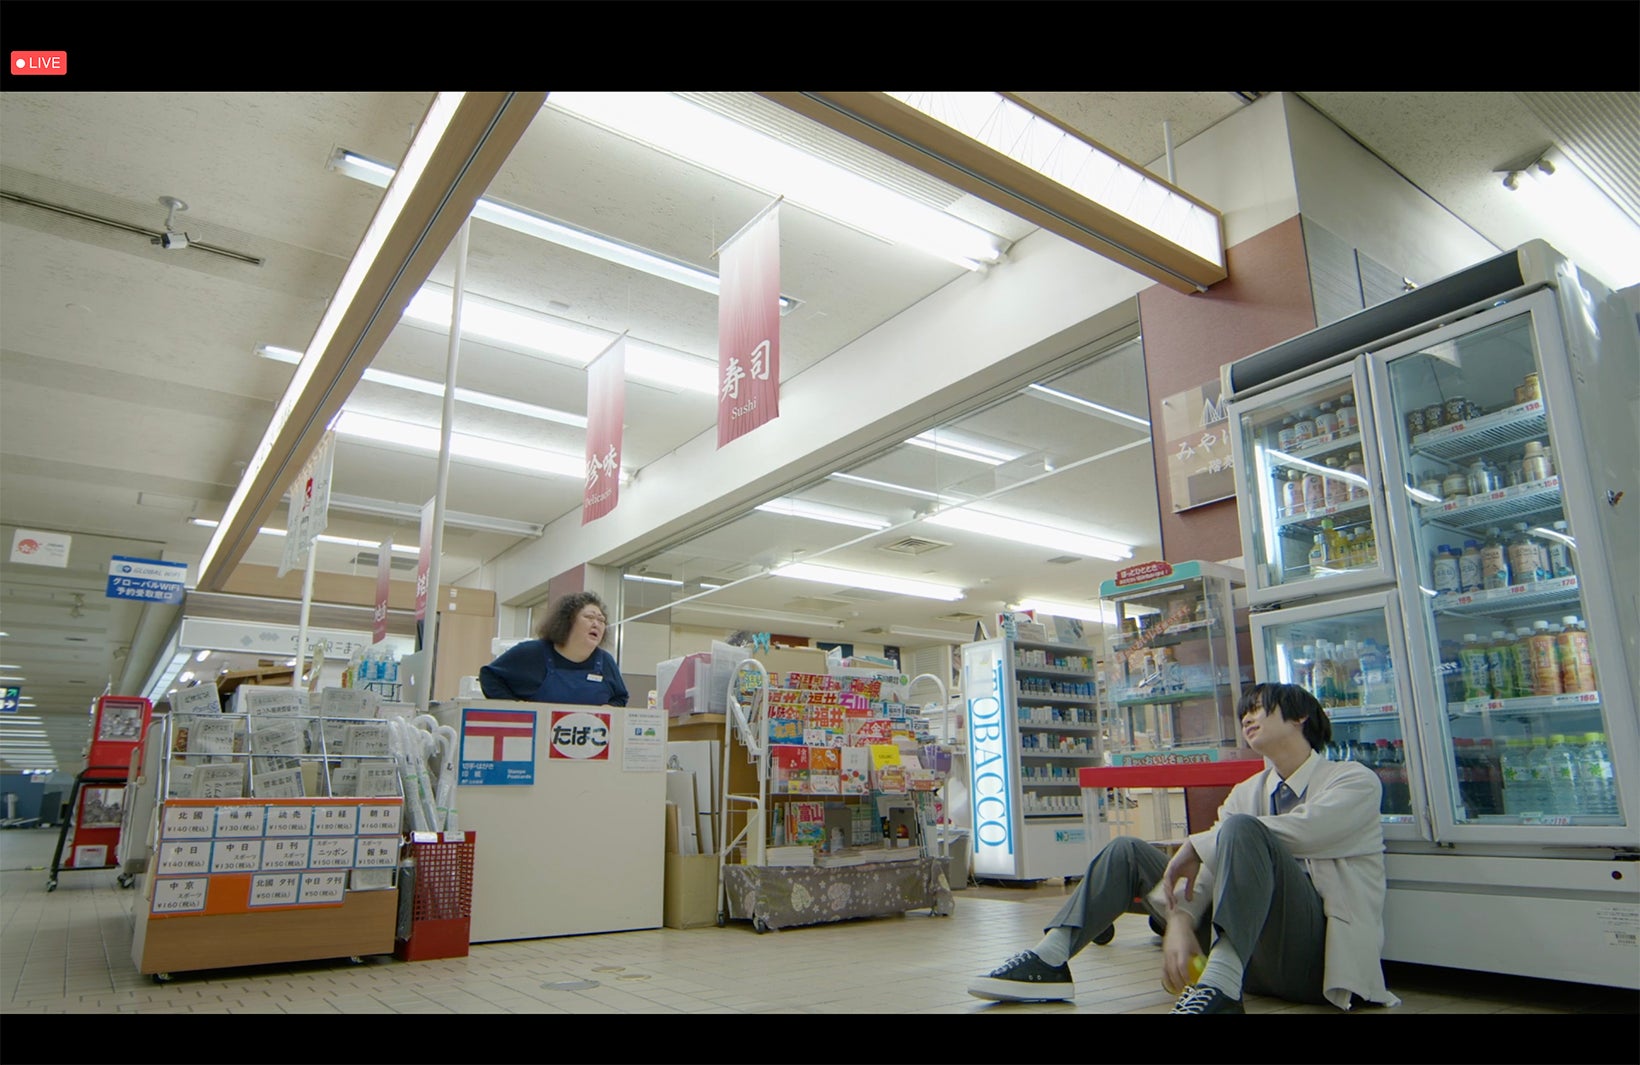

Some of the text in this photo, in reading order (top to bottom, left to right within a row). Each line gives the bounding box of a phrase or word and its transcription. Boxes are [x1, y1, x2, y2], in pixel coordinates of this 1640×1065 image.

[721, 339, 771, 402] 寿司
[731, 396, 758, 419] Sushi
[585, 444, 618, 490] 珍味
[814, 706, 843, 728] 福井
[553, 725, 608, 746] たばこ
[179, 811, 203, 820] 北國
[230, 811, 253, 819] 福井
[278, 810, 302, 819] 読売
[325, 810, 347, 818] 日経
[370, 809, 390, 817] 朝日
[799, 803, 824, 822] 富山
[174, 846, 198, 855] 中日
[226, 843, 249, 852] 中日
[276, 842, 299, 850] 日刊
[318, 848, 348, 857] ニッポン
[367, 848, 388, 857] 報知
[256, 878, 295, 887] 北國 夕刊
[305, 877, 342, 885] 中日 夕刊
[169, 881, 194, 891] 中京
